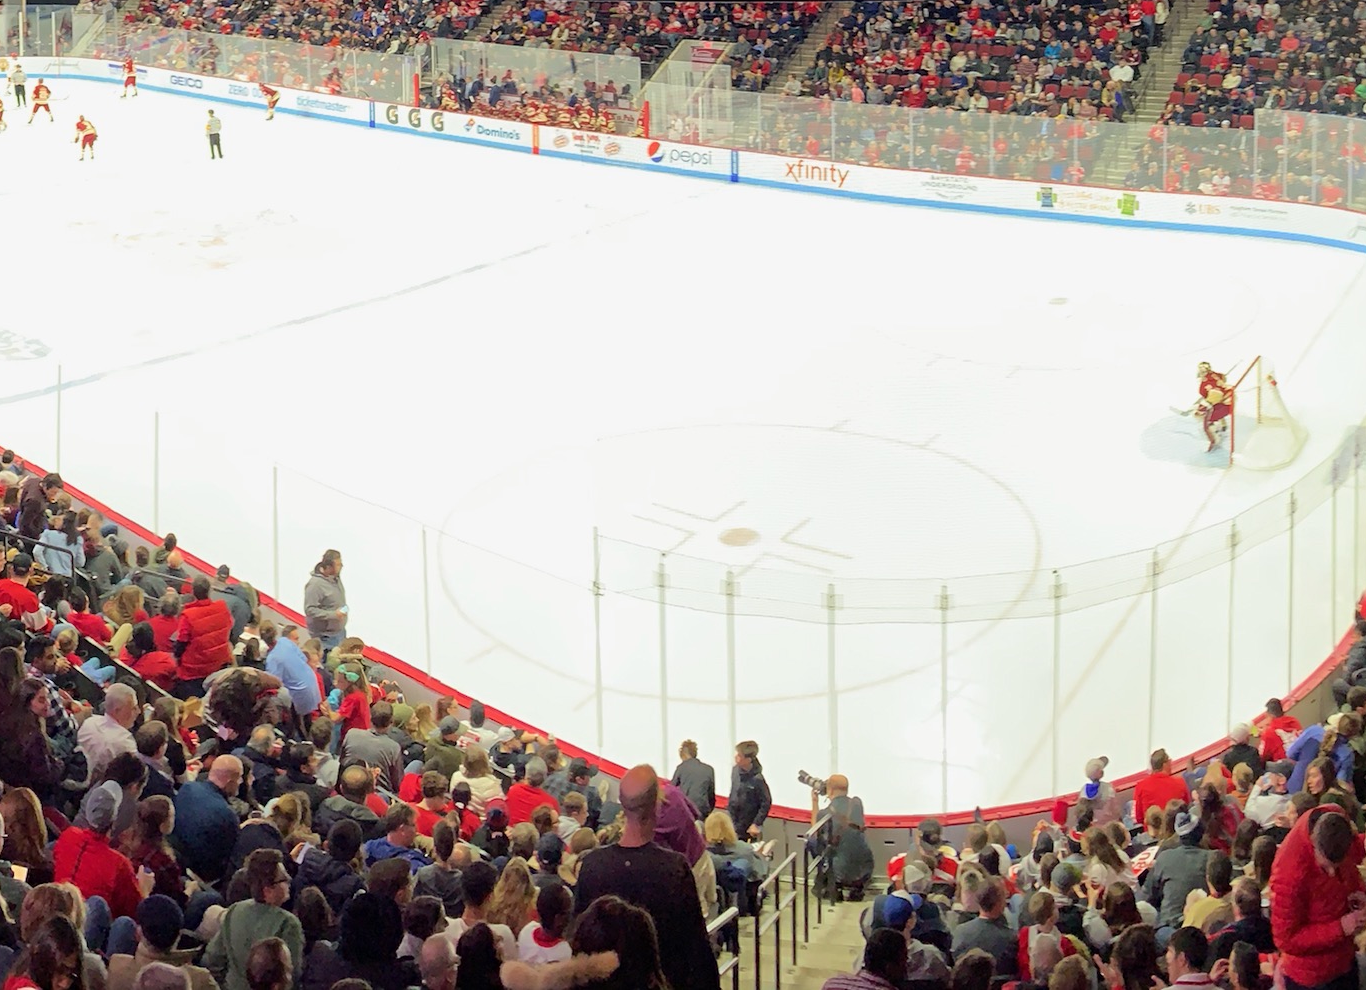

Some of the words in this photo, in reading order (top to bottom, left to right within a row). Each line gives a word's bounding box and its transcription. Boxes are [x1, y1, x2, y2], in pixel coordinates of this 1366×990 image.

[170, 75, 203, 89] GEICO
[296, 96, 350, 112] ticketmaster
[386, 105, 398, 124] G
[408, 108, 421, 128] G
[432, 112, 444, 131] G
[477, 125, 520, 140] Domino's
[670, 149, 712, 166] pepsi
[785, 160, 849, 188] xfinity
